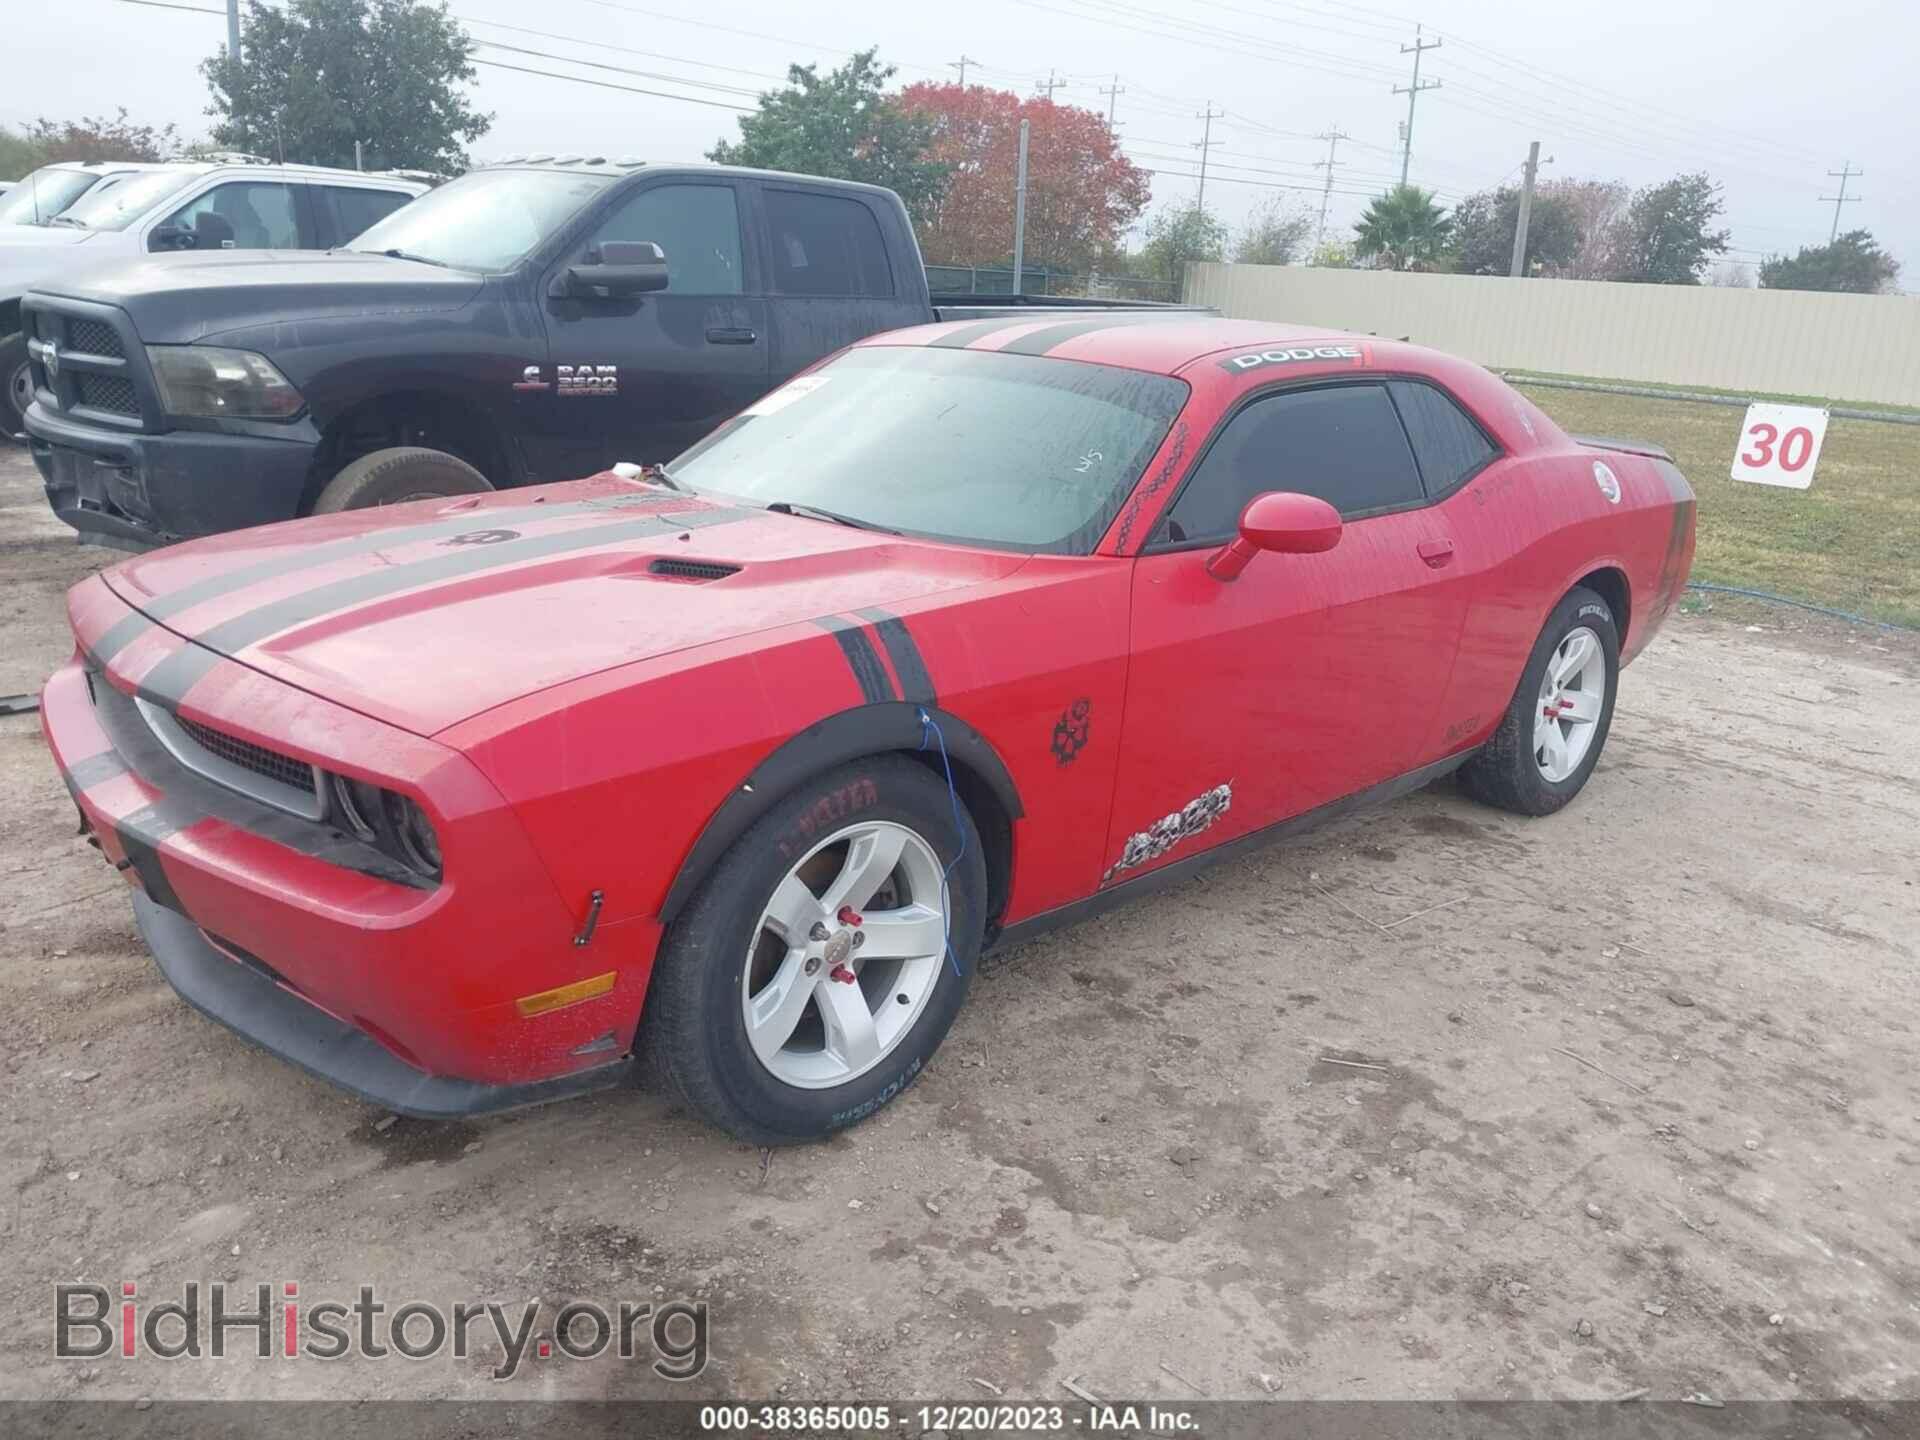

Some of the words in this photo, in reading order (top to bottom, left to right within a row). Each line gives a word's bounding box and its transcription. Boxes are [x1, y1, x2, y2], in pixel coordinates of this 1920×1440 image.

[1231, 346, 1362, 369] DODGE
[557, 365, 617, 377] RAM
[1742, 423, 1814, 472] 30
